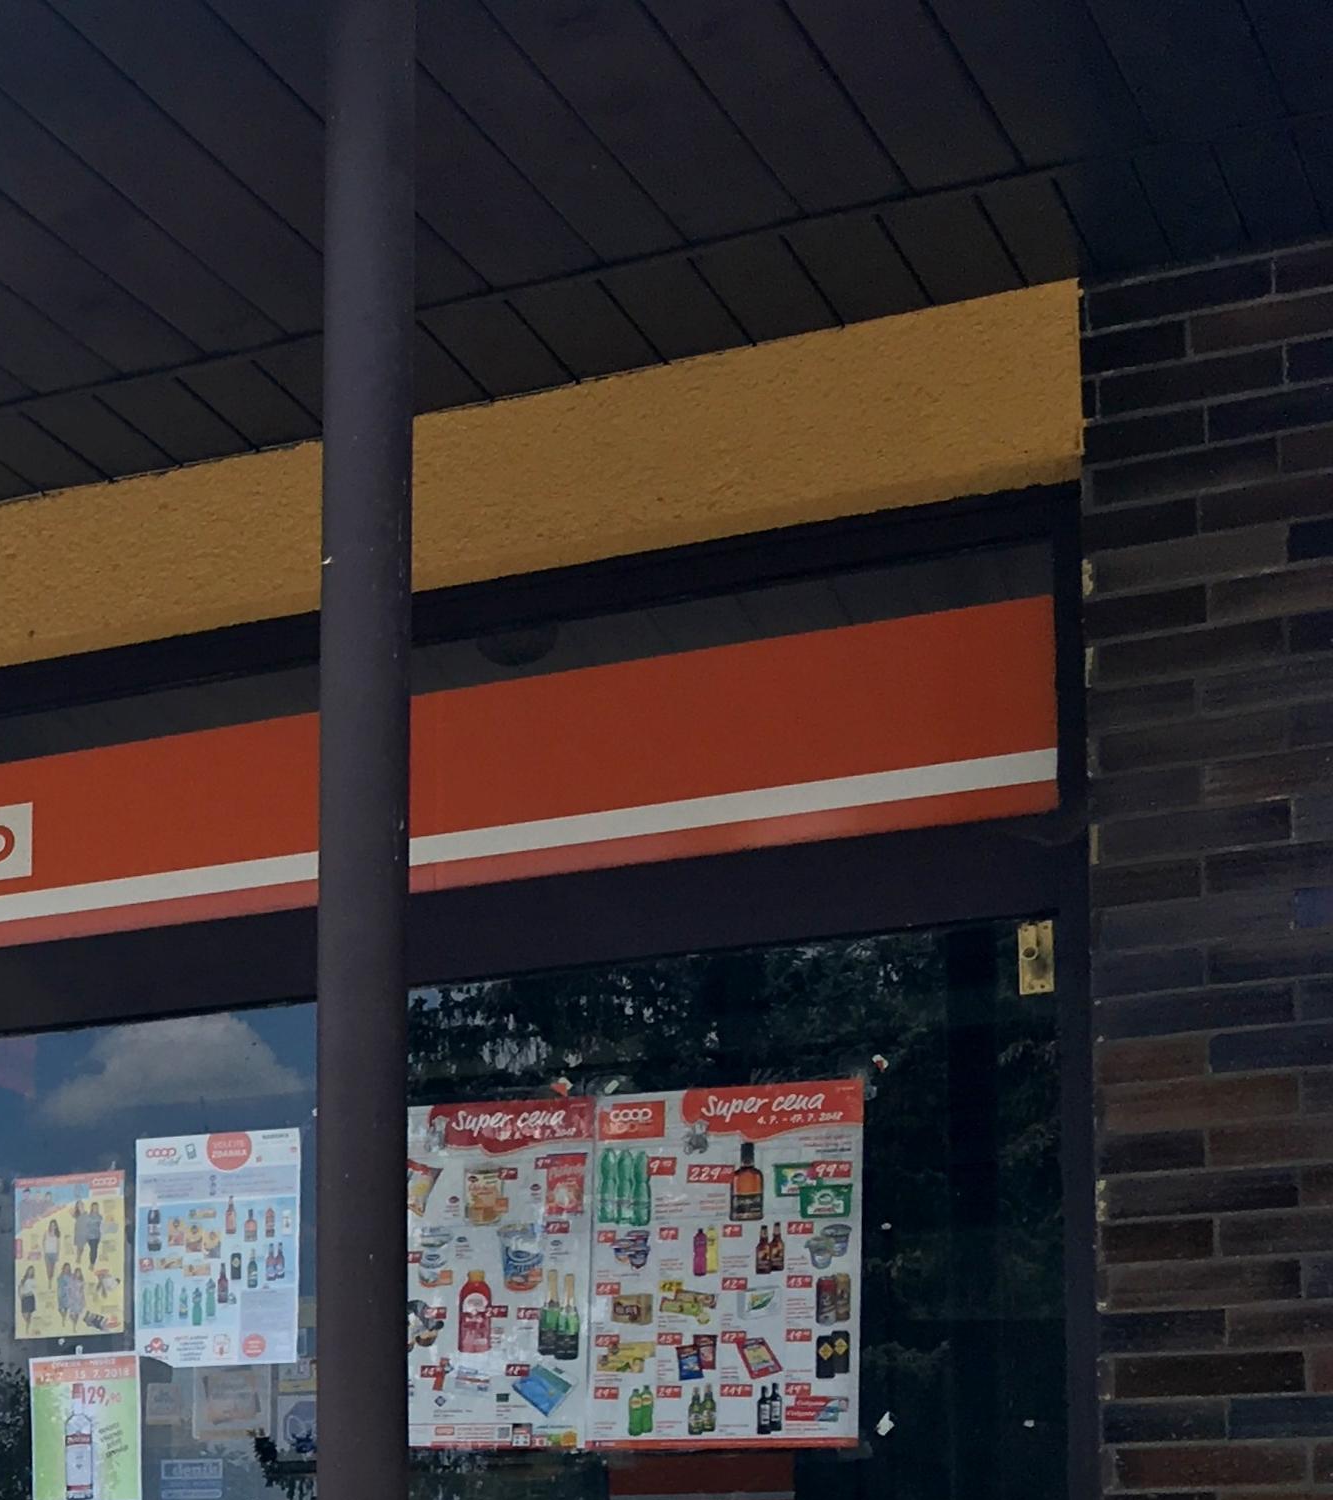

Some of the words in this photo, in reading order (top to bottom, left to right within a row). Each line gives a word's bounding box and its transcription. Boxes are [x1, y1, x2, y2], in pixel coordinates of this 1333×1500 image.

[610, 1108, 653, 1123] coop
[701, 1095, 769, 1123] Super
[771, 1093, 825, 1112] cena
[452, 1110, 514, 1137] Super
[517, 1110, 566, 1127] cena
